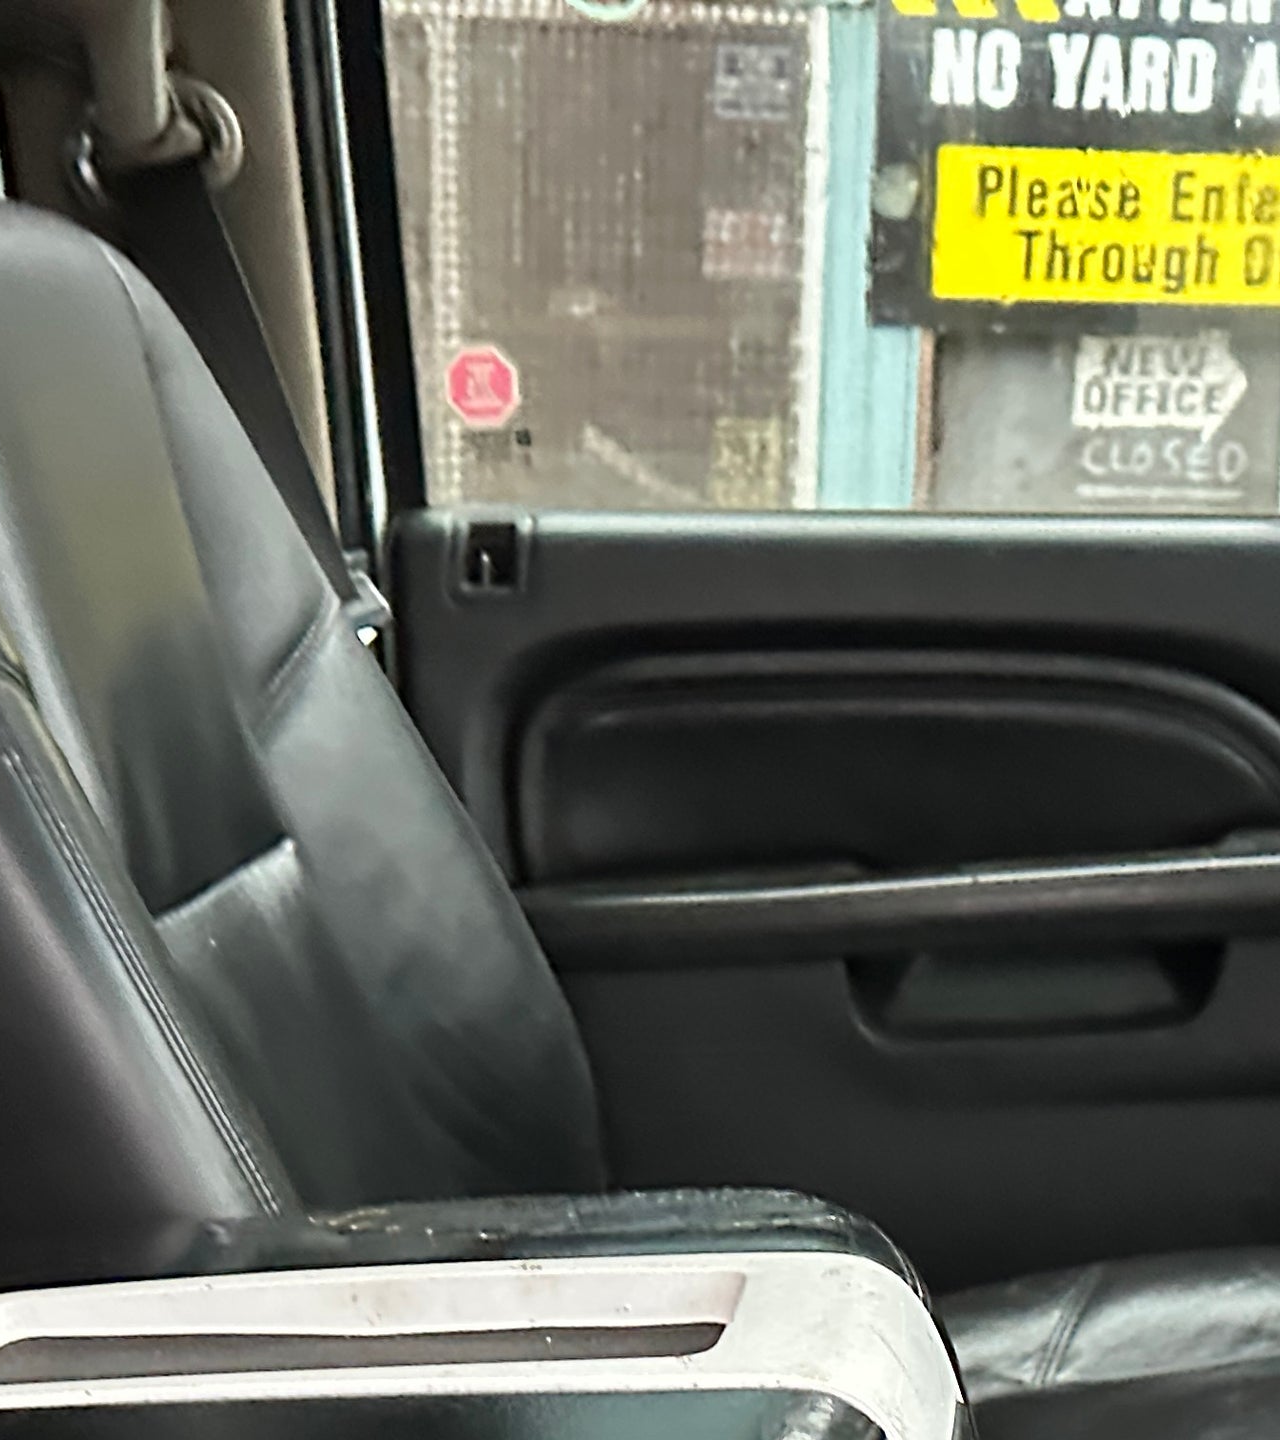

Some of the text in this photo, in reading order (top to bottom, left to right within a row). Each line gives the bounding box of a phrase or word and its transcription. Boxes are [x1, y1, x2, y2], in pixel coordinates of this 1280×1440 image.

[931, 28, 1020, 108] NO
[1048, 33, 1218, 113] YARD
[976, 164, 1141, 222] Please
[1015, 229, 1219, 294] Through
[1102, 342, 1206, 376] NEW
[1082, 374, 1224, 416] OFFICE
[1080, 437, 1249, 483] CLOSED
